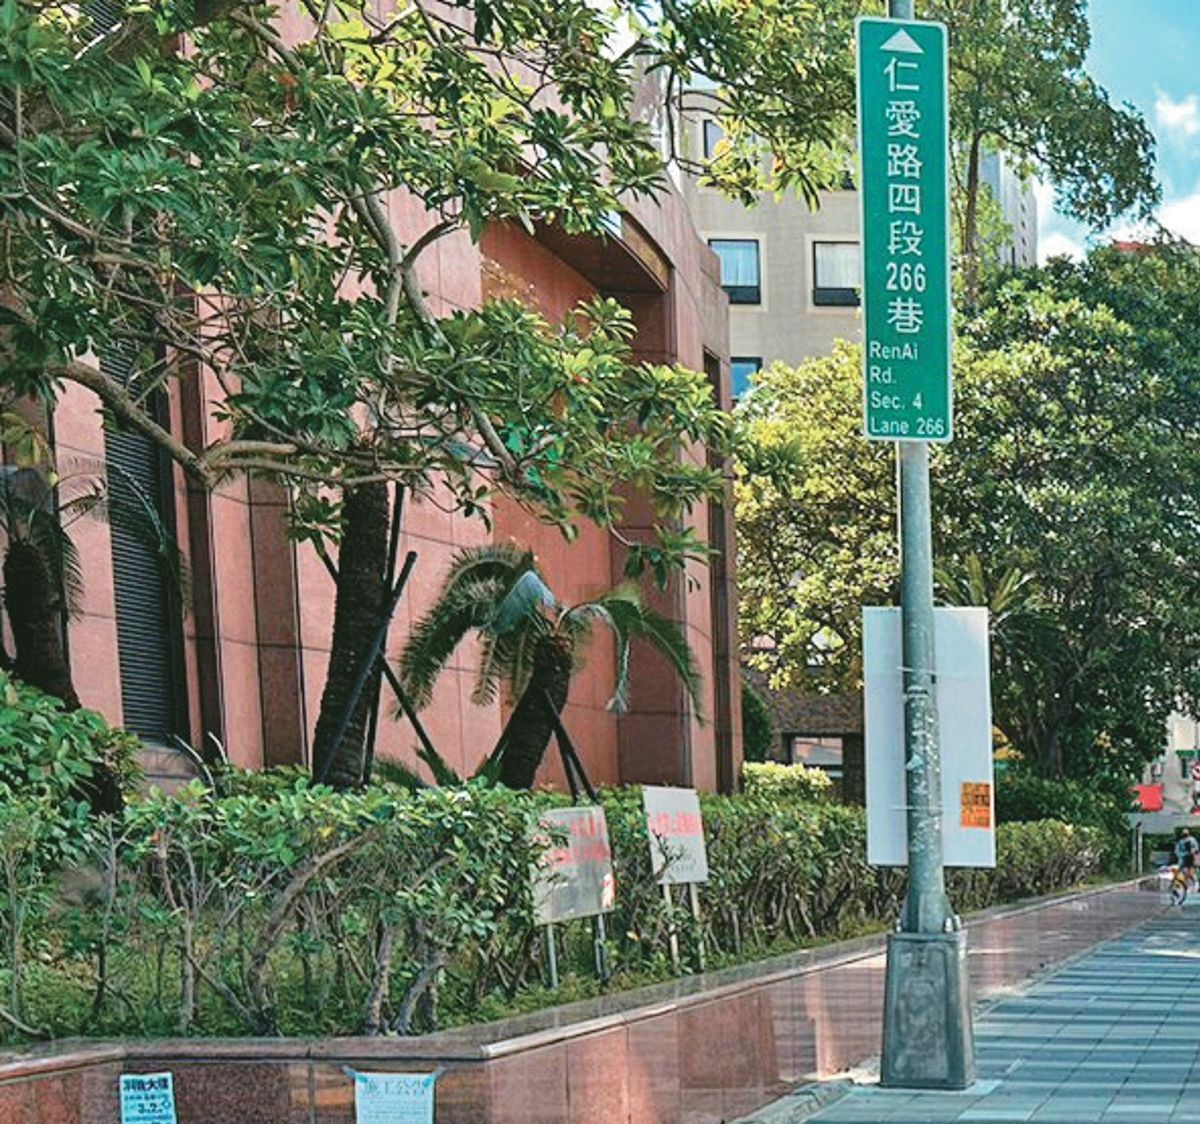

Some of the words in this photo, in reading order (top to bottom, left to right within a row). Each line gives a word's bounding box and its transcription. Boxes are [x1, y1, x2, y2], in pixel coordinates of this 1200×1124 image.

[883, 56, 927, 334] 仁愛路四段266巷
[869, 341, 918, 360] RenAi
[869, 365, 897, 384] Rd.
[870, 389, 905, 409] Sec.
[912, 392, 923, 410] 4
[870, 418, 909, 435] Lane
[916, 418, 945, 436] 266
